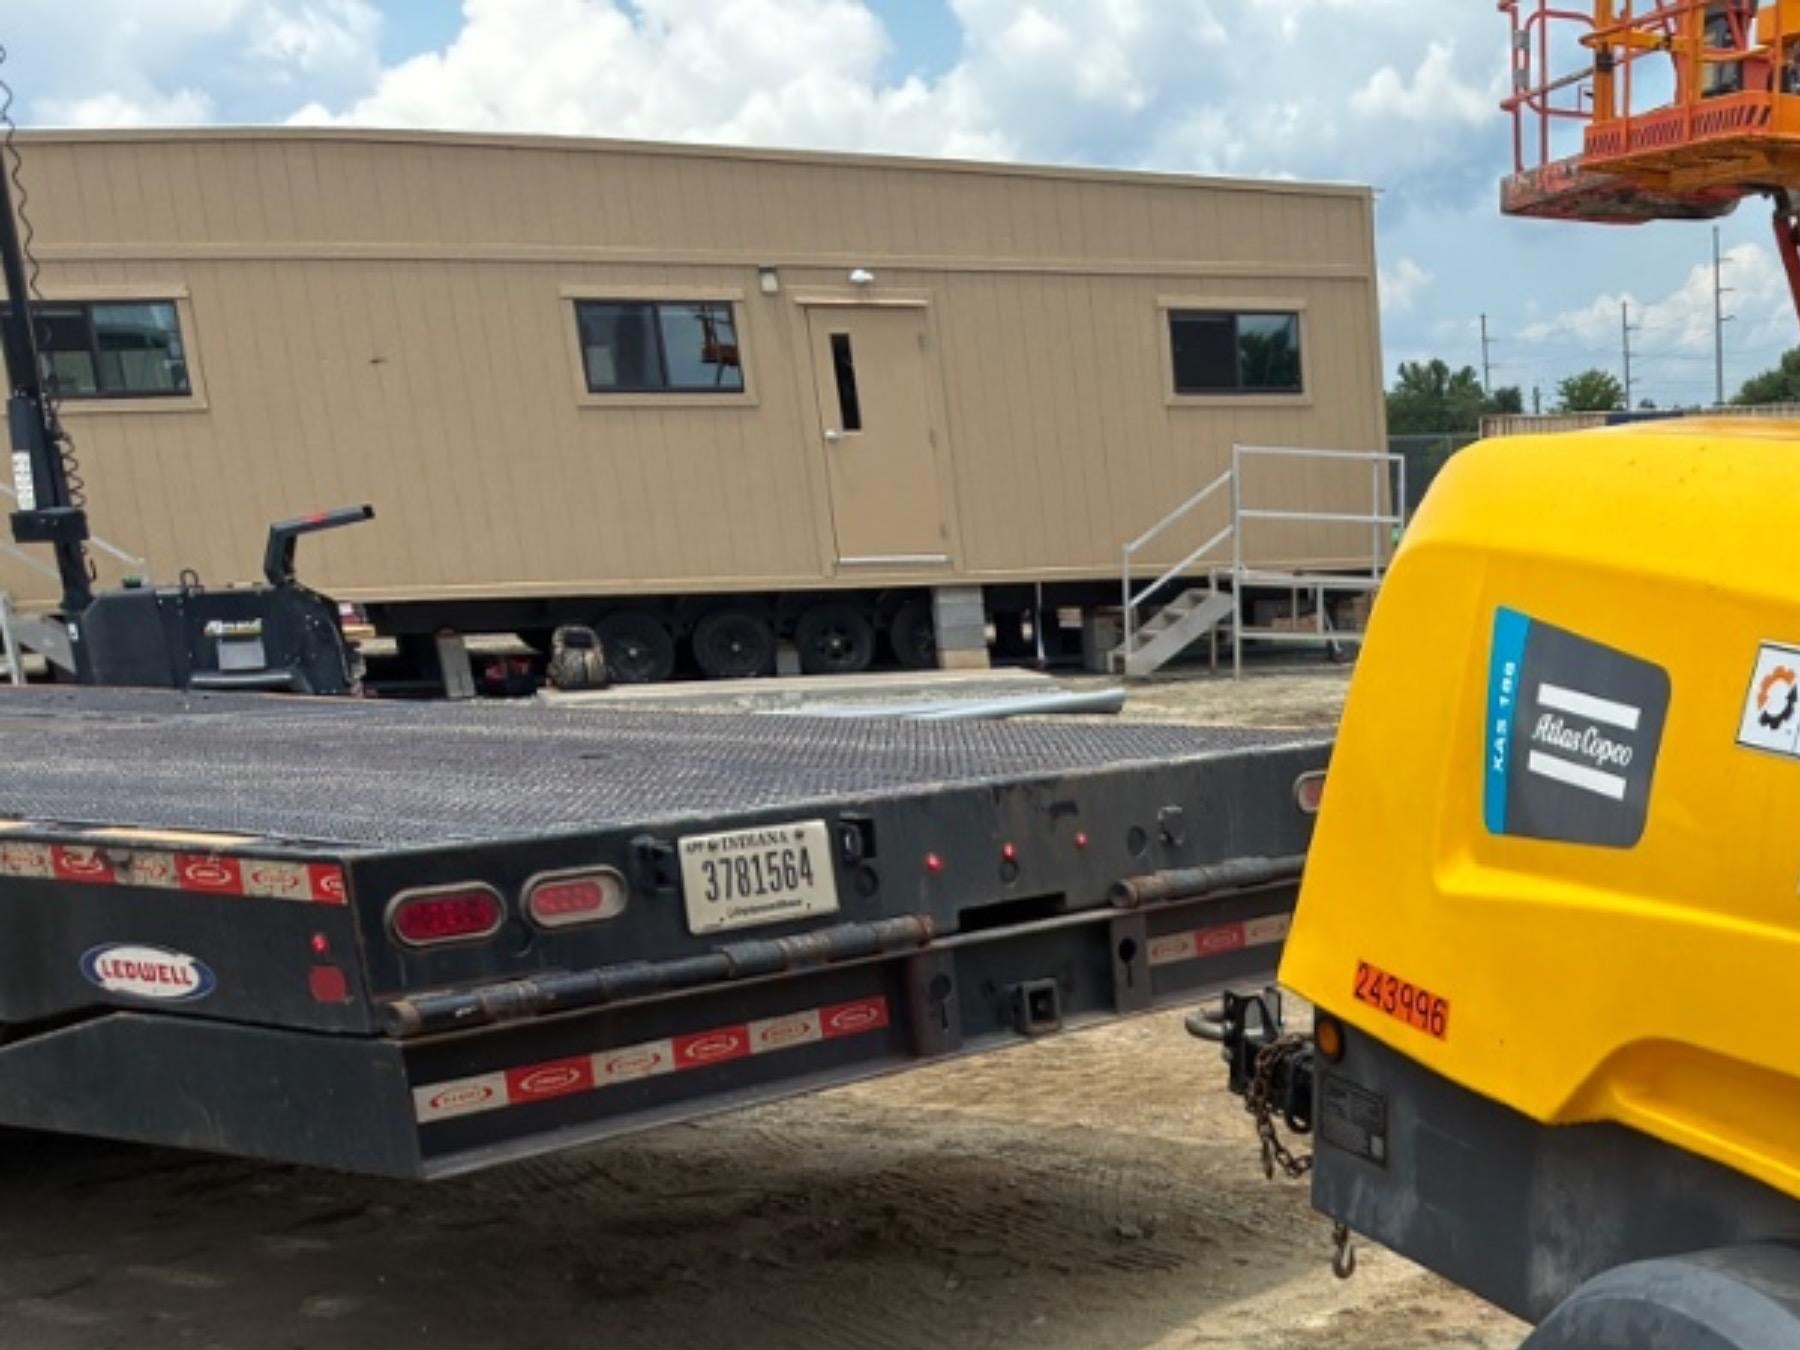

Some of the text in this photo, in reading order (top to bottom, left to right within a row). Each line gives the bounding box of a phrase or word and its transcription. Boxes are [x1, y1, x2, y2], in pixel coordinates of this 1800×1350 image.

[1532, 713, 1633, 766] Atlas Copco
[720, 829, 789, 851] INDIANA
[702, 847, 814, 903] 3781564
[101, 958, 194, 986] LEDWELL
[1355, 961, 1447, 1038] 243996
